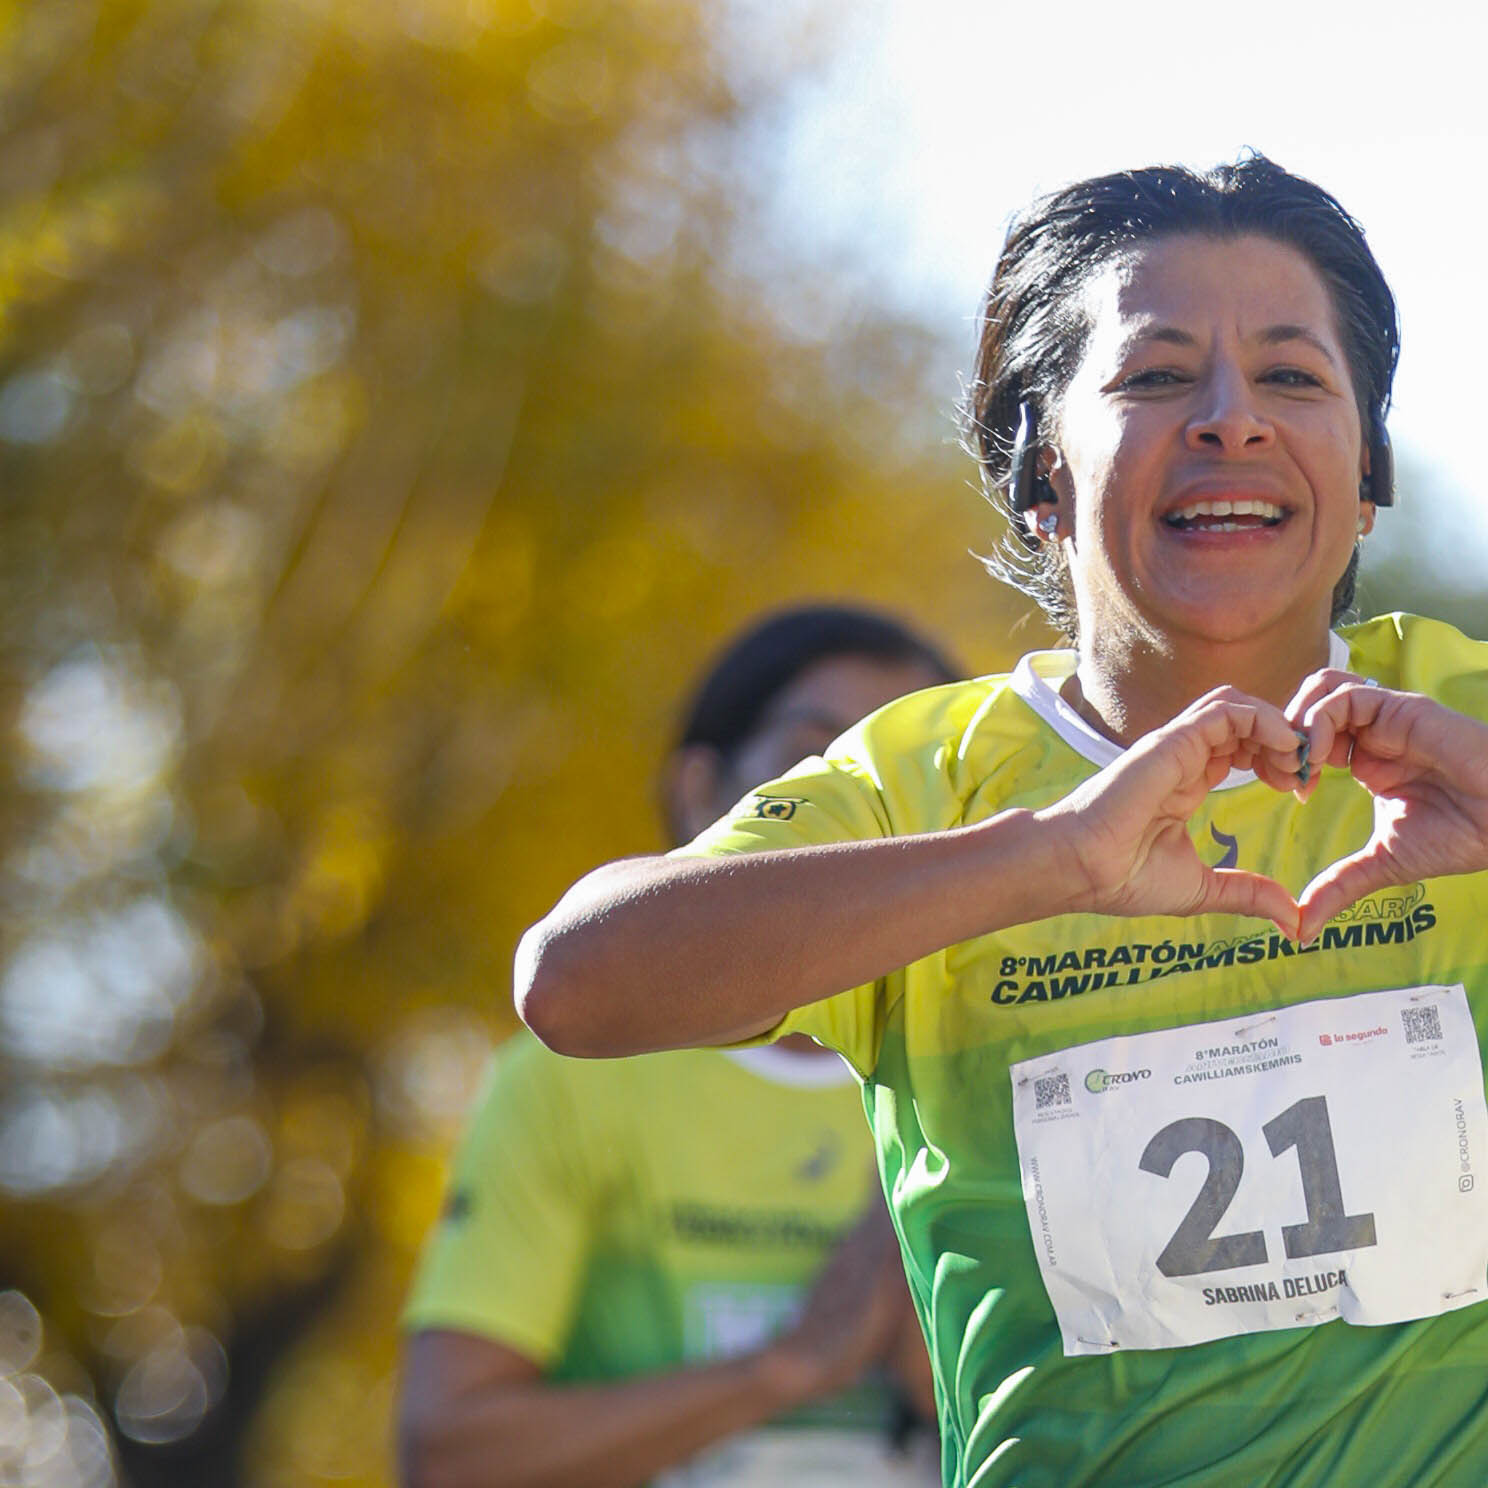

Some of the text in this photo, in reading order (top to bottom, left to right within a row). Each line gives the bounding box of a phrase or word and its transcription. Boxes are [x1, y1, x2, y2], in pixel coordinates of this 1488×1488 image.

[1173, 1054, 1303, 1085] CAWILLIAMSKEMMIS
[1138, 1095, 1377, 1277] 21
[1202, 1269, 1349, 1306] SABRINA DELUCA
